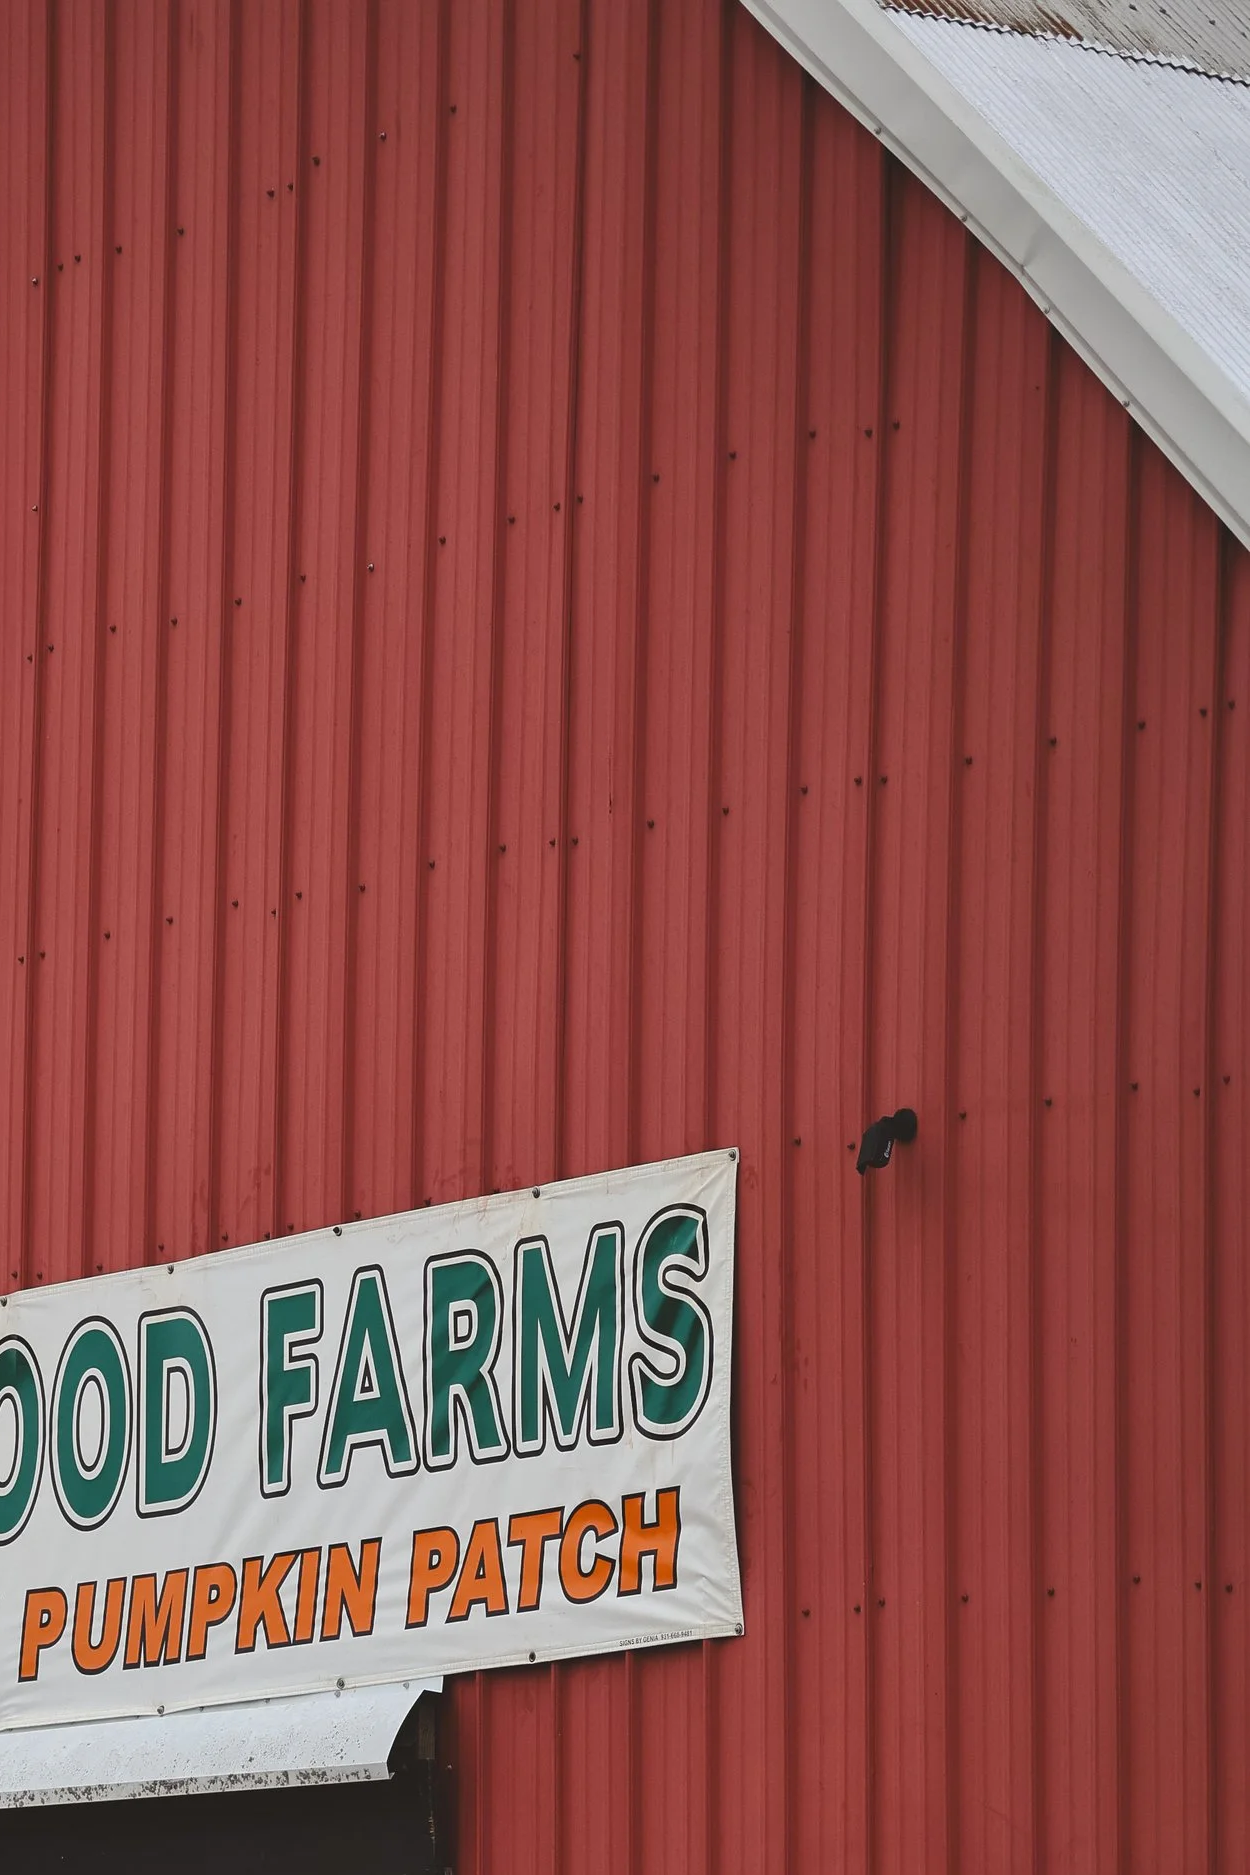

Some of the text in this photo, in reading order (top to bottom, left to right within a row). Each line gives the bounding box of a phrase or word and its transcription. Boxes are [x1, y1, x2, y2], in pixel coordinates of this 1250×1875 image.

[260, 1203, 714, 1498] FARMS
[18, 1537, 382, 1682] PUMPKIN
[404, 1486, 682, 1630] PATCH
[619, 1638, 635, 1647] SIGNS
